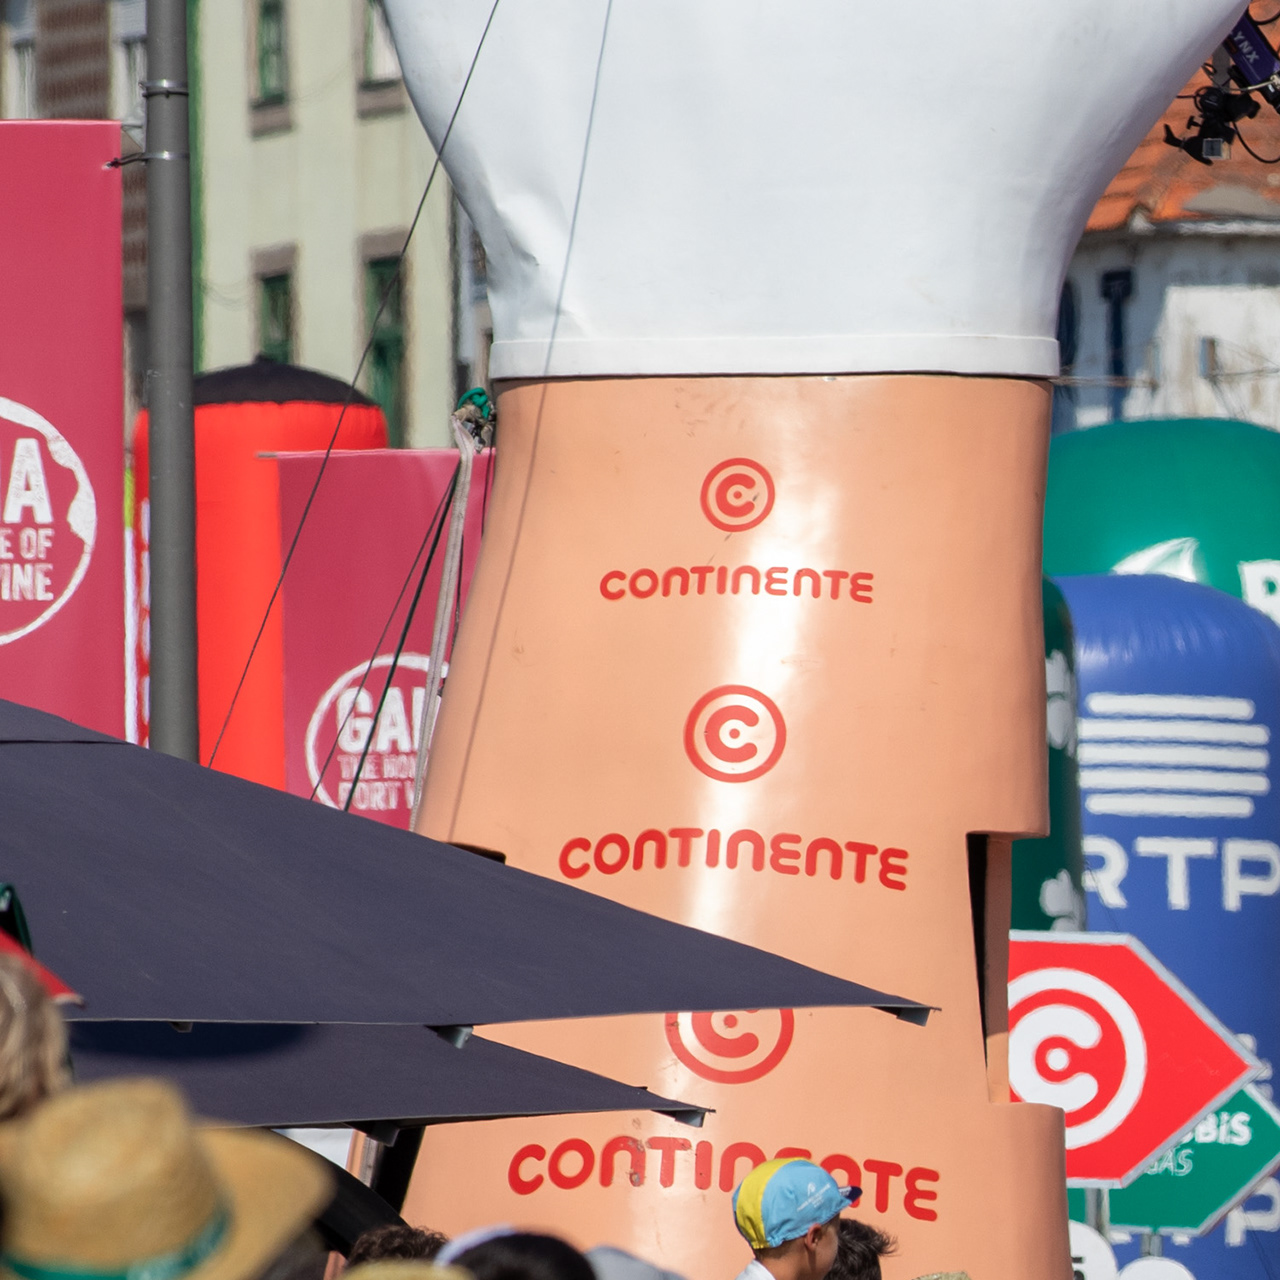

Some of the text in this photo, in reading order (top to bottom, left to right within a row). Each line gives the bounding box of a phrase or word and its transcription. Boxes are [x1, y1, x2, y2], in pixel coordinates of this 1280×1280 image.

[20, 528, 54, 559] OF
[0, 564, 54, 601] INE
[599, 565, 875, 604] CONTINENTE
[558, 828, 910, 892] CONTINENTE
[507, 1134, 941, 1222] CONTINNTE
